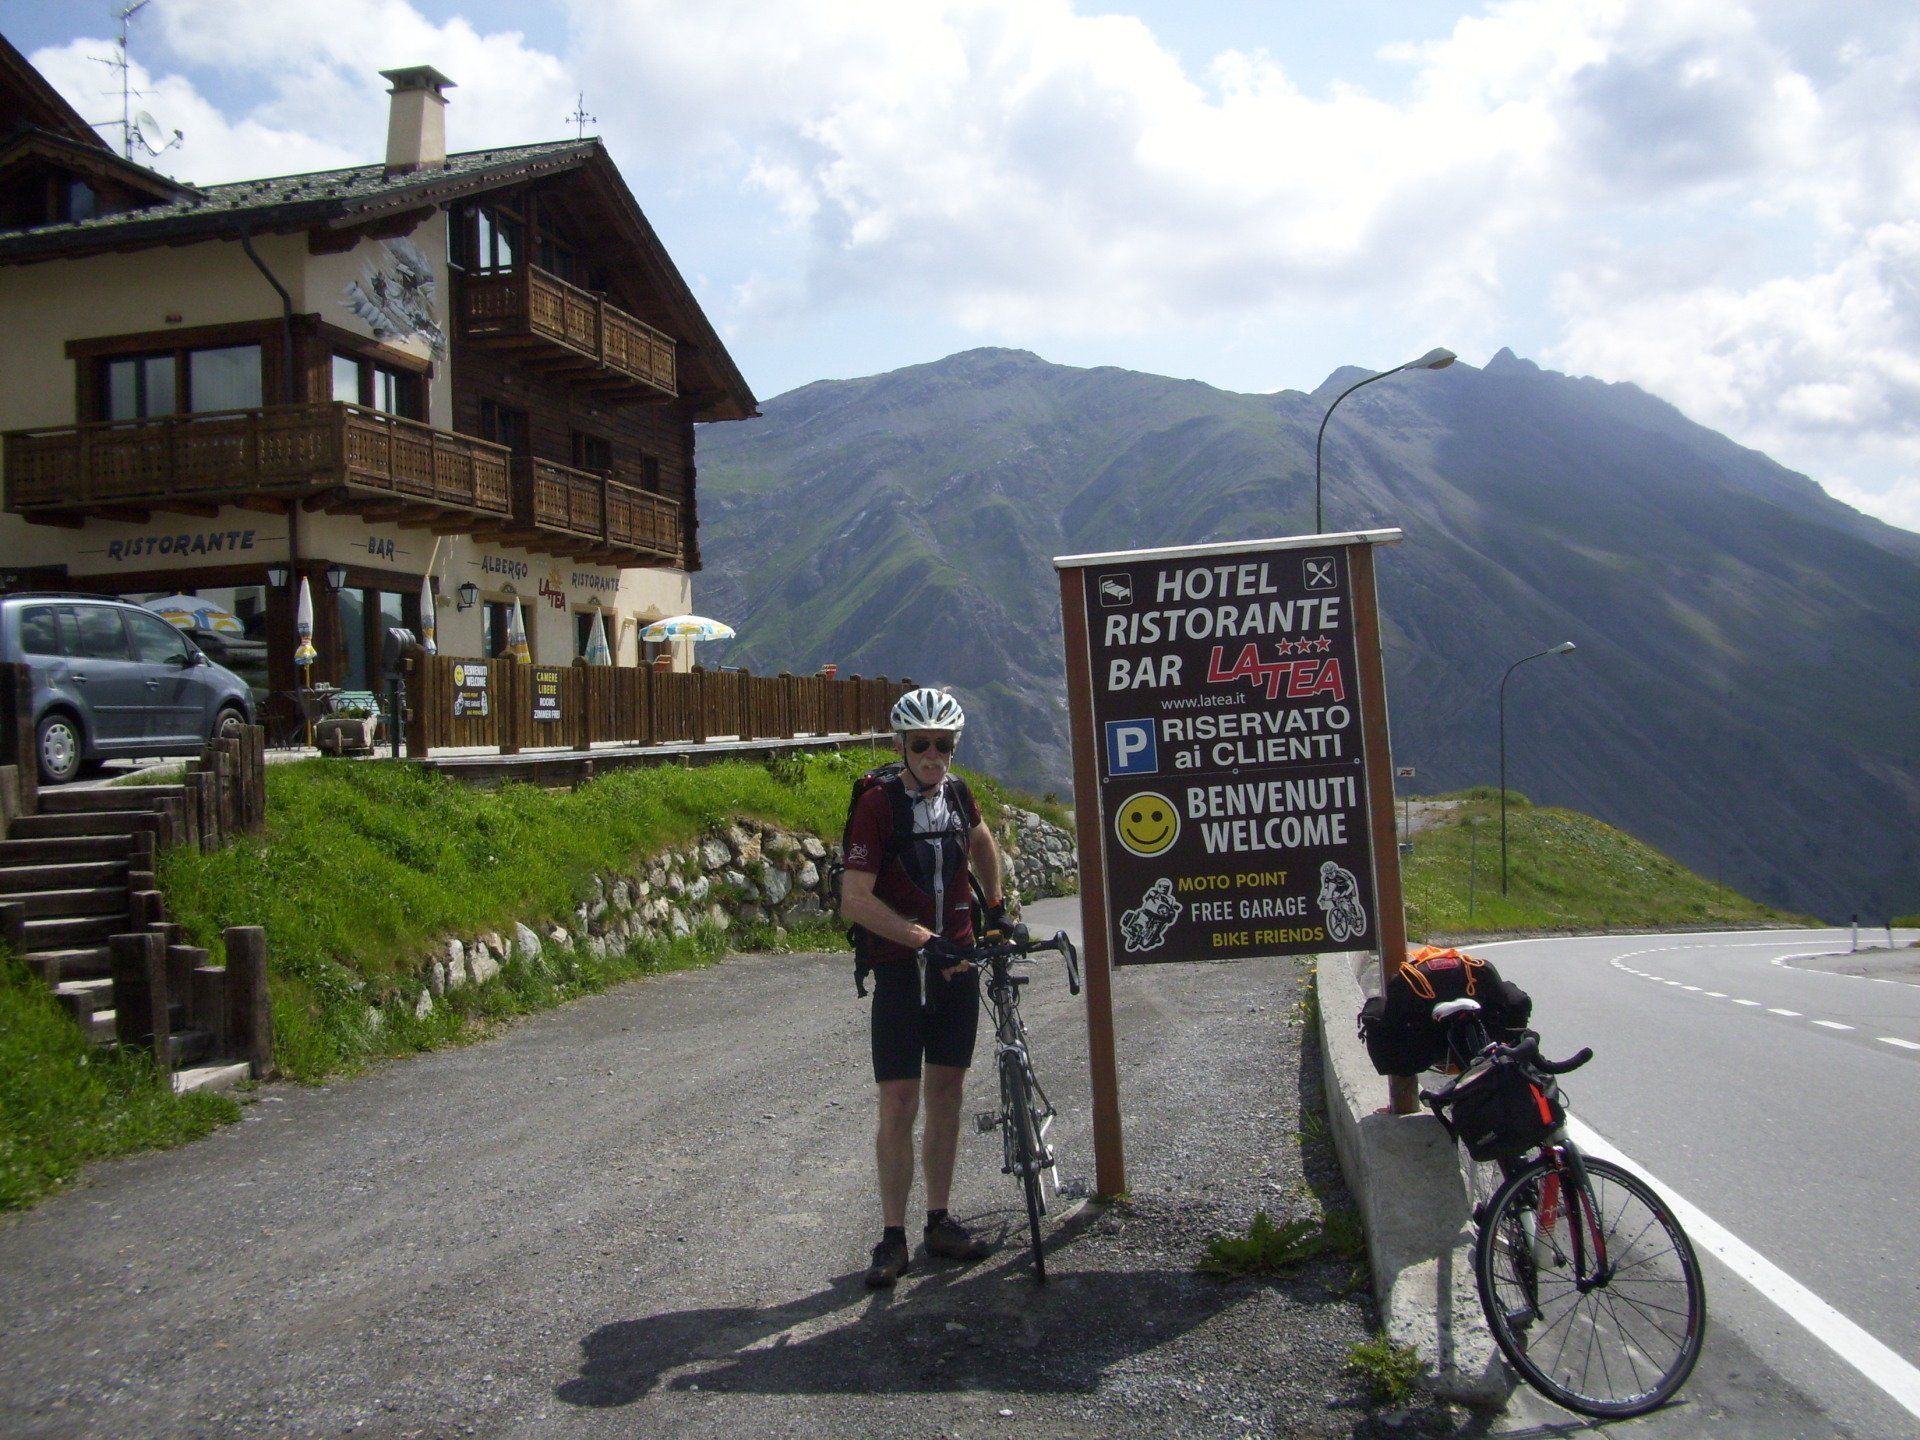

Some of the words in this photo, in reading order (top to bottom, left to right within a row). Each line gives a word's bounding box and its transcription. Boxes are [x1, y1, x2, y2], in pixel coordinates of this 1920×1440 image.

[107, 530, 256, 561] RISTORANTE
[367, 536, 395, 562] BAR
[481, 555, 529, 580] ALBERGO
[571, 572, 620, 592] RISTORANTE
[1156, 562, 1278, 603] HOTEL
[1104, 597, 1340, 647] RISTORANTE
[1108, 654, 1183, 691] BAR
[1161, 692, 1246, 710] www.latea.it
[1162, 705, 1351, 742] RISERVATO
[1115, 726, 1148, 768] P
[1175, 745, 1201, 769] ai
[1212, 734, 1342, 766] CLIENTI
[1187, 776, 1356, 819] BENVENUTI
[1201, 813, 1348, 853] WELCOME
[1178, 874, 1230, 892] MOTO
[1236, 871, 1288, 888] POINT
[1191, 901, 1233, 922] FREE
[1240, 896, 1308, 919] GARAGE
[1212, 931, 1249, 947] BIKE
[1255, 927, 1325, 944] FRIENDS
